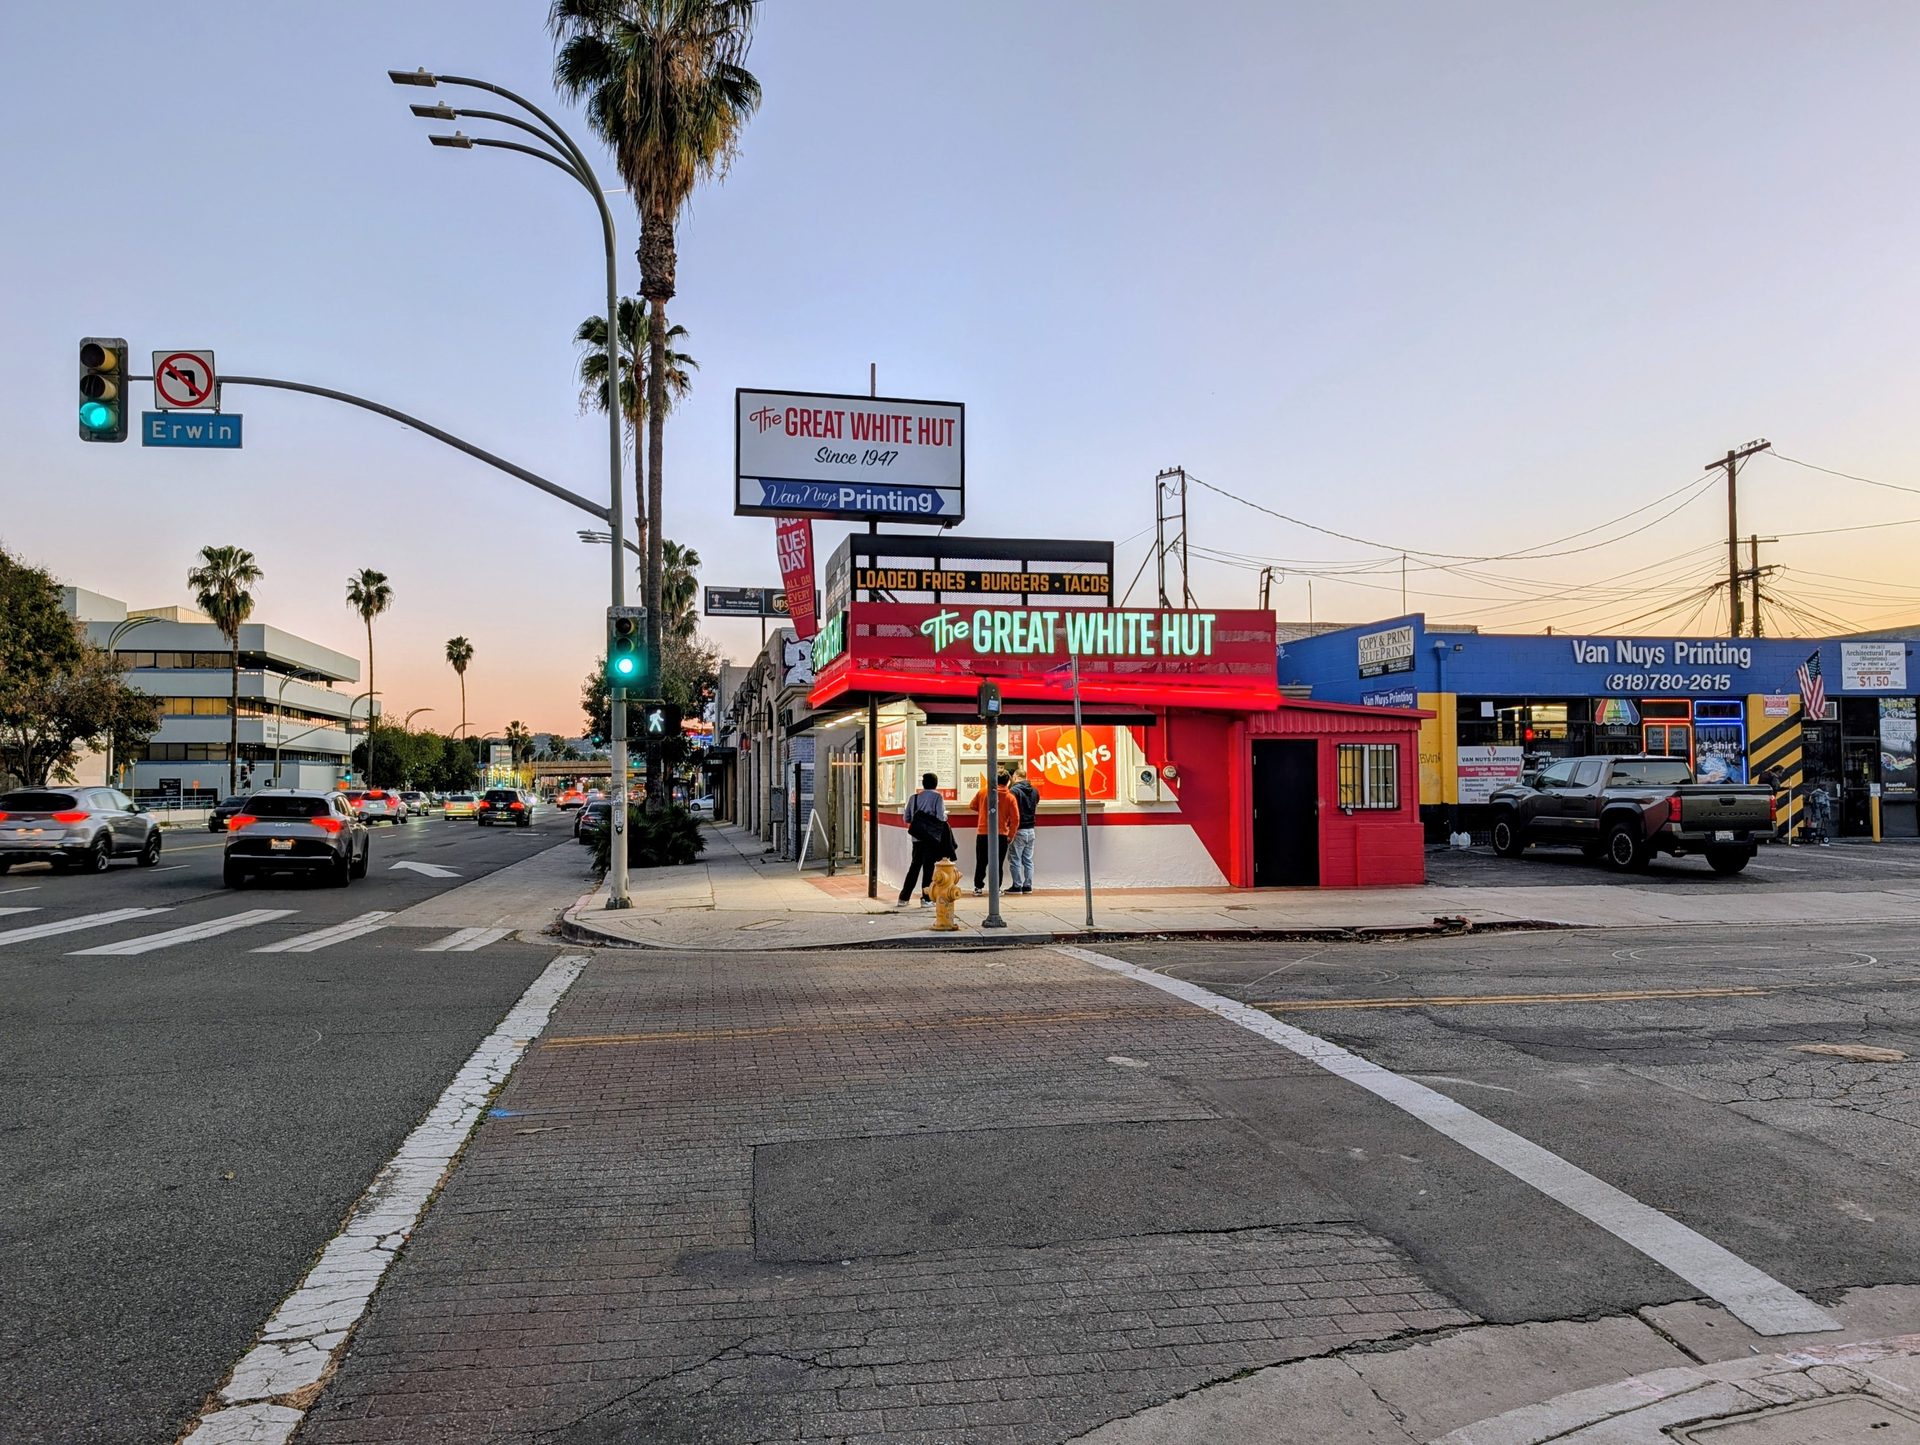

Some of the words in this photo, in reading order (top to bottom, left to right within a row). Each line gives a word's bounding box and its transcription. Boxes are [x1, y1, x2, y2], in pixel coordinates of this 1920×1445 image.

[152, 421, 232, 439] Erwin
[749, 405, 782, 434] The
[785, 407, 845, 439] GREAT
[850, 412, 913, 444] WHITE
[918, 417, 955, 446] HUT
[814, 446, 857, 465] Since
[861, 450, 898, 466] 1947
[767, 484, 802, 505] Van
[802, 485, 837, 508] Nuys
[839, 487, 932, 512] Printing
[777, 528, 807, 555] TUES
[780, 548, 806, 573] DAY
[857, 570, 917, 589] LOADED
[922, 571, 966, 590] FRIES
[981, 573, 1049, 592] BURGERS
[1063, 574, 1110, 593] TACOS
[773, 600, 789, 610] ups
[788, 589, 809, 602] EVERY
[920, 609, 969, 654] The
[973, 610, 1060, 653] GREAT
[1065, 612, 1155, 655] WHITE
[1162, 613, 1216, 656] HUT
[1359, 635, 1378, 651] COPY
[1379, 635, 1385, 647] &
[1387, 629, 1411, 645] PRINT
[1572, 640, 1609, 664] Van
[1616, 640, 1665, 669] Nuys
[1674, 641, 1751, 669] Printing
[1605, 674, 1731, 691] (818)780-2615
[1859, 676, 1889, 687] $1.50
[1363, 695, 1374, 706] Van
[1374, 694, 1389, 707] Nuys
[1389, 691, 1414, 705] Printing
[1703, 741, 1737, 750] T-shirt
[1706, 752, 1735, 760] Printing
[1030, 743, 1075, 772] VAN
